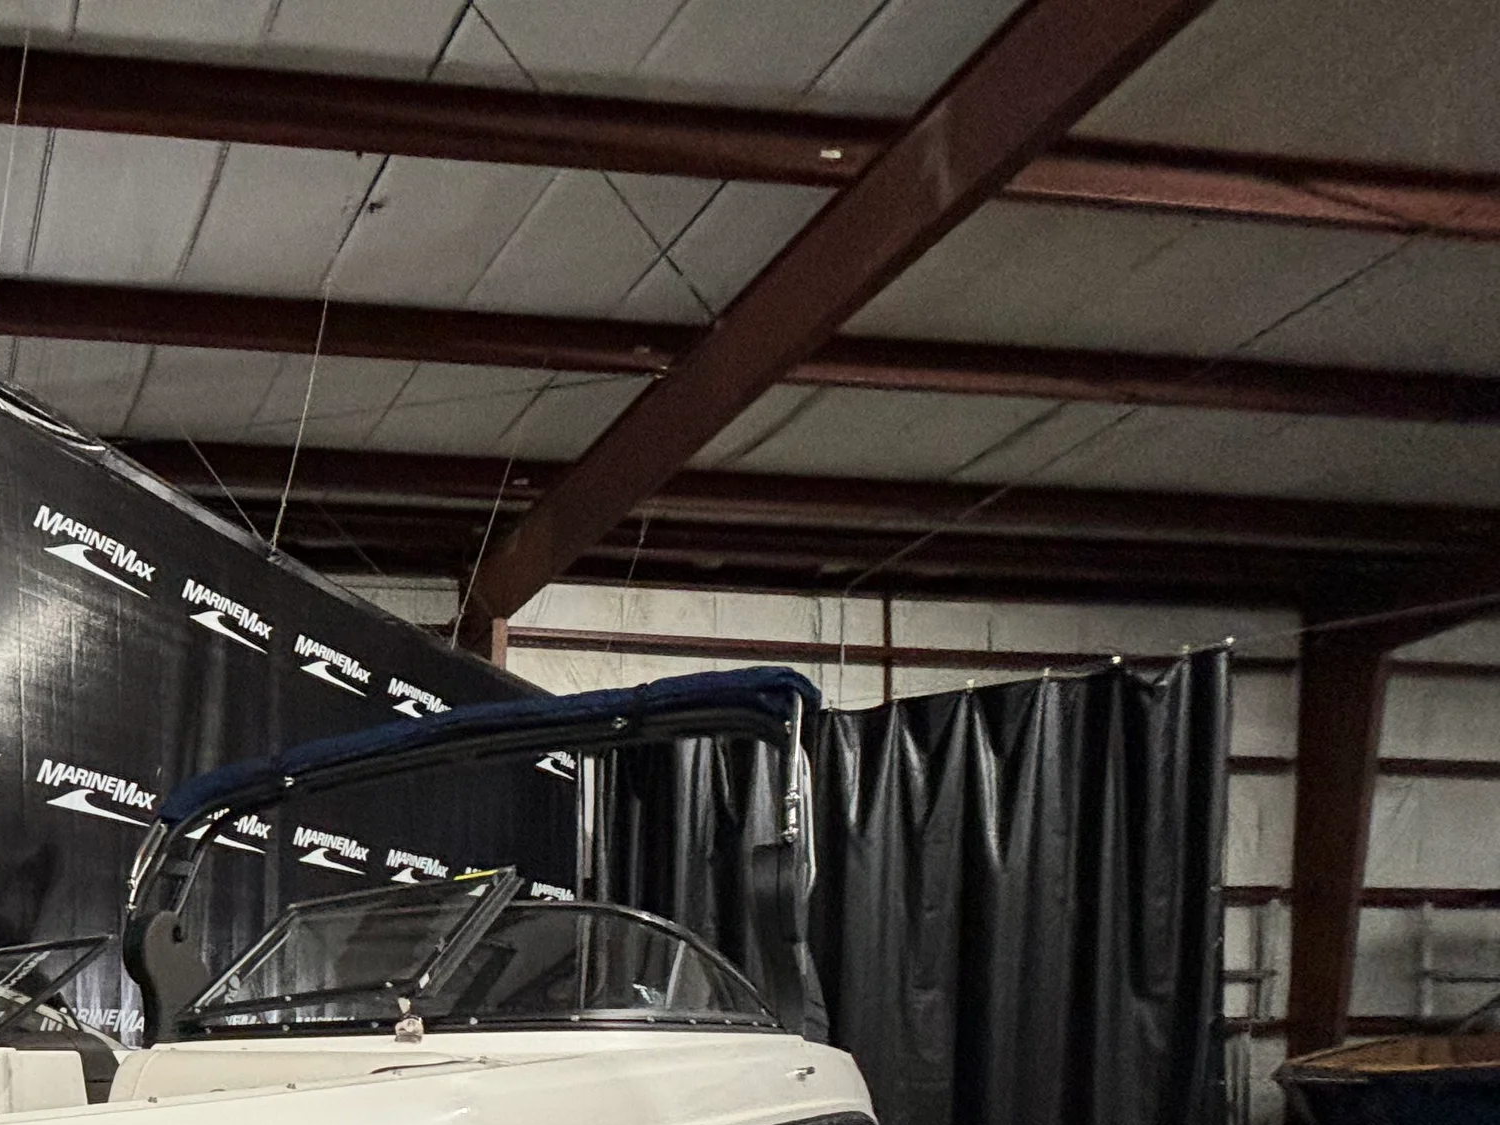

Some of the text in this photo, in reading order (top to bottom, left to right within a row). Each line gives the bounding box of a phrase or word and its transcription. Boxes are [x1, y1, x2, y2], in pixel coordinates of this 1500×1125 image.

[33, 504, 156, 582] MARINEMAX
[181, 578, 273, 640] MARINEMAX
[294, 634, 371, 684] MARINEMAX
[36, 758, 157, 810] MARINEMAX
[292, 826, 370, 862] MARINEMAX
[386, 848, 450, 879] MARINEMAX
